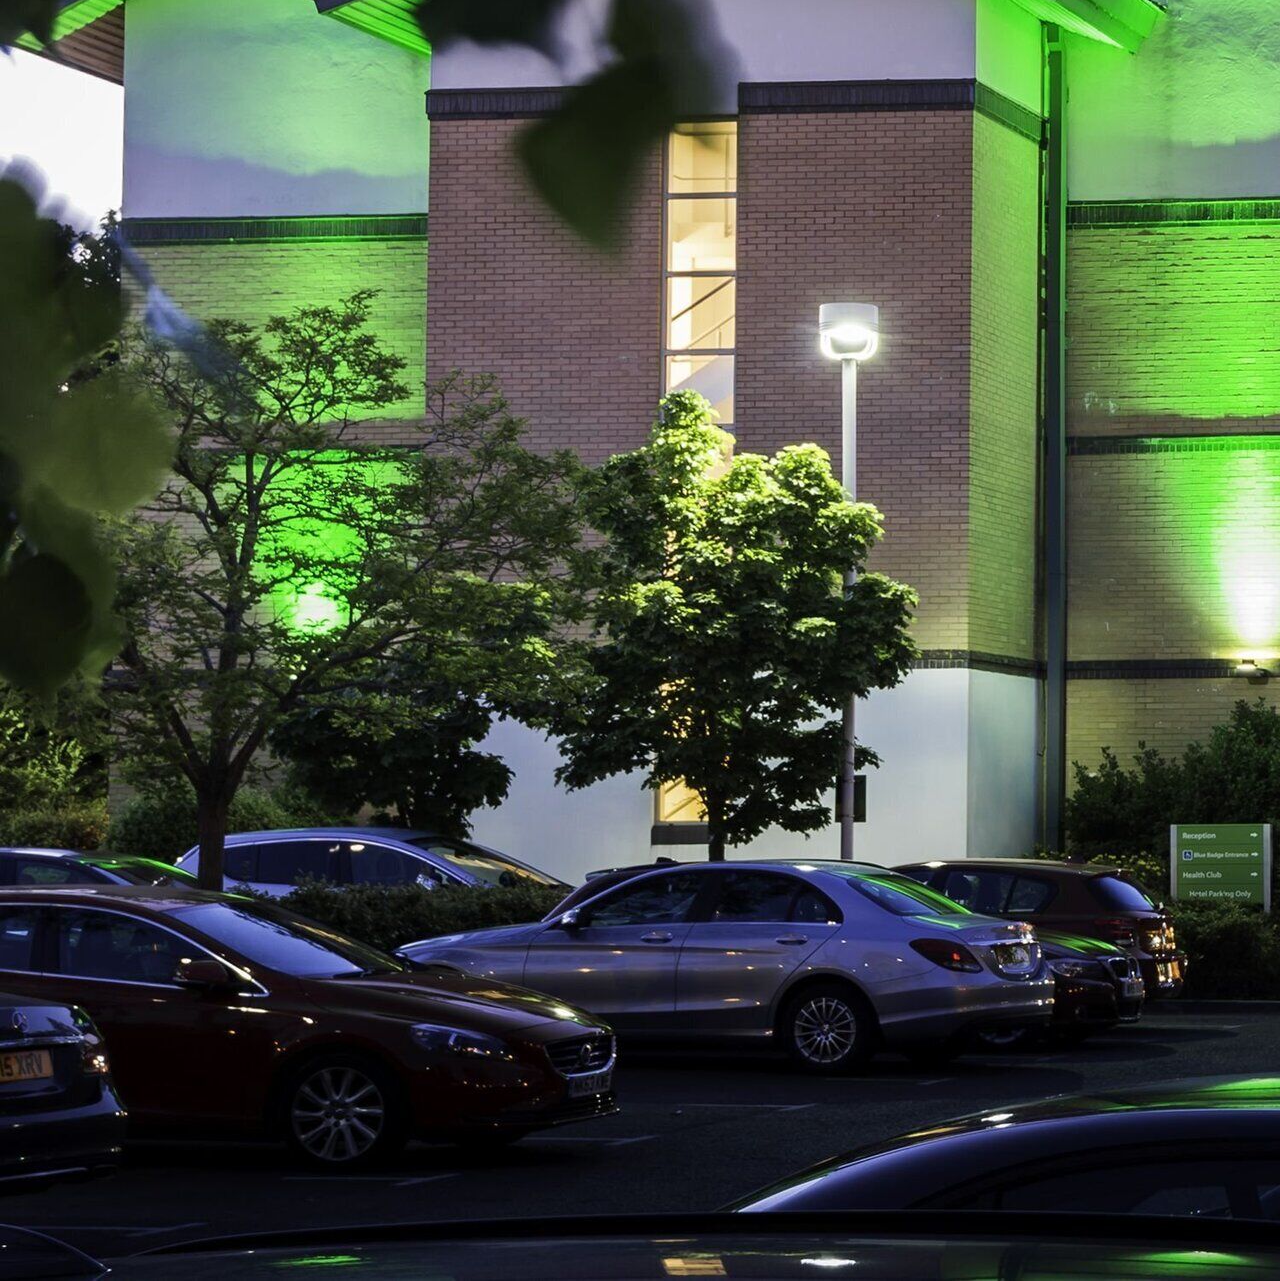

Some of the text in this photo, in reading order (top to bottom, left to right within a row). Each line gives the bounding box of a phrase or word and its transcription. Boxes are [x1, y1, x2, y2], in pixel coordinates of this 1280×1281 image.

[1182, 832, 1217, 841] Reception
[1208, 890, 1234, 898] Parking
[1235, 890, 1252, 898] Only
